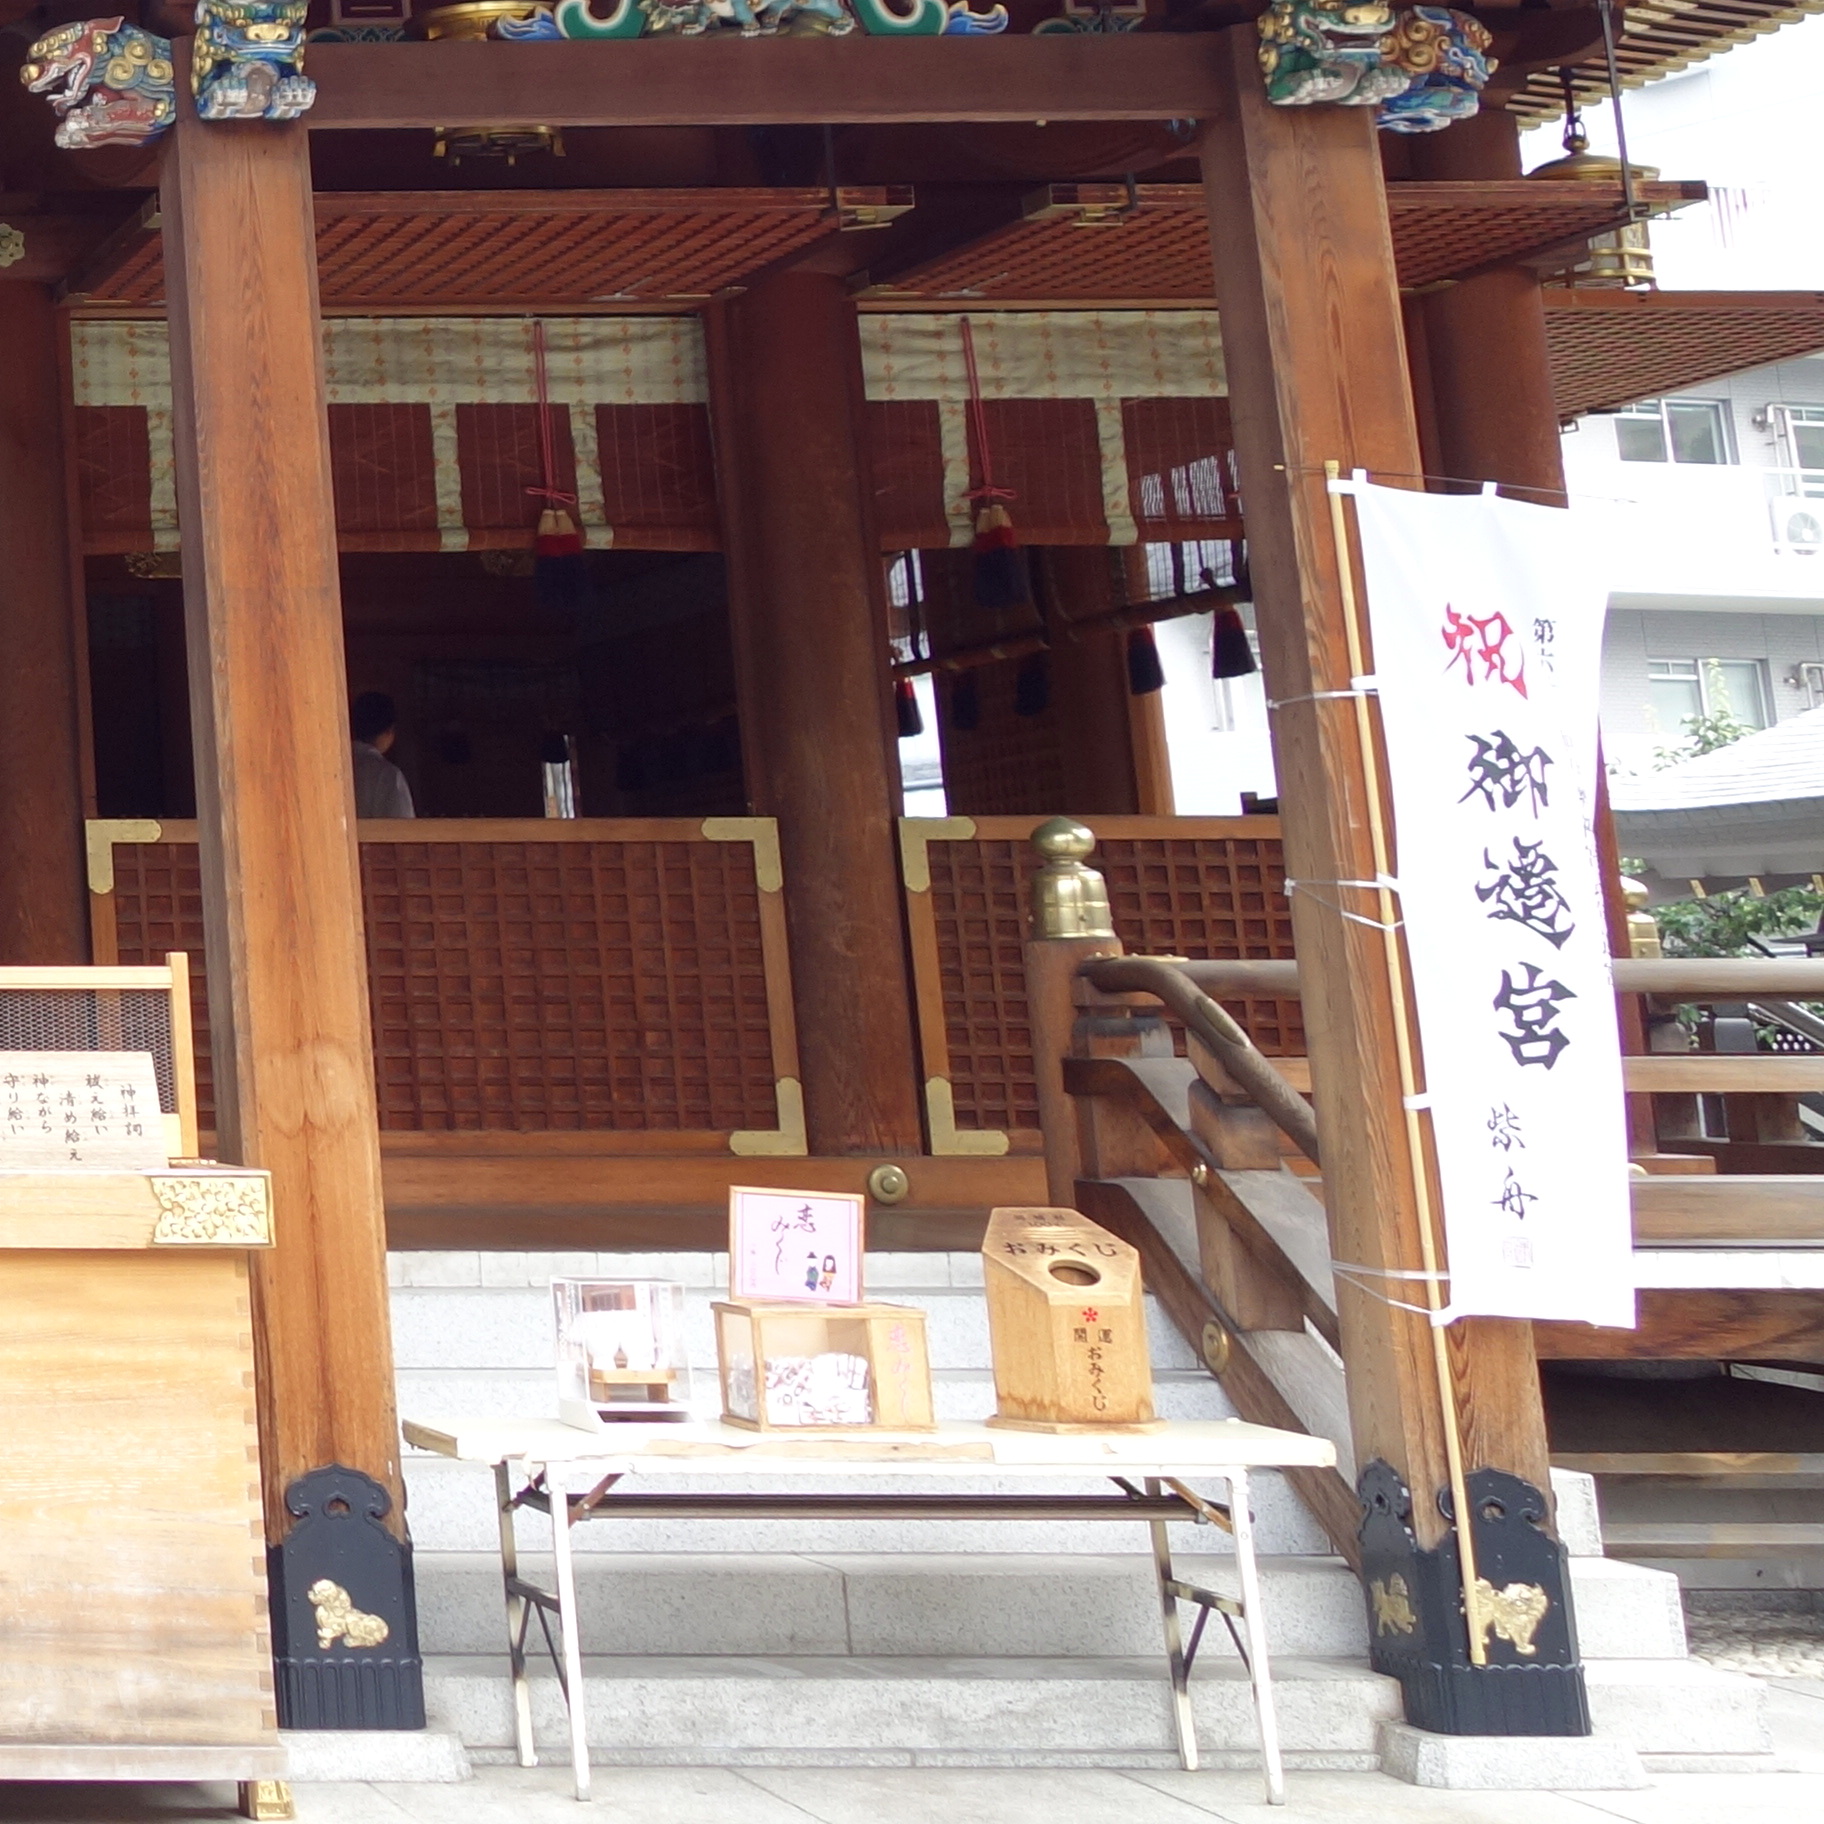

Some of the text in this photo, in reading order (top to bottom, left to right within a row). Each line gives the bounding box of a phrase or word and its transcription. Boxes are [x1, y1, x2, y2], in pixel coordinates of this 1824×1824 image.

[119, 1083, 144, 1137] 神拝詞
[1003, 1242, 1118, 1257] おみくじ
[1087, 1346, 1107, 1412] おみくじ
